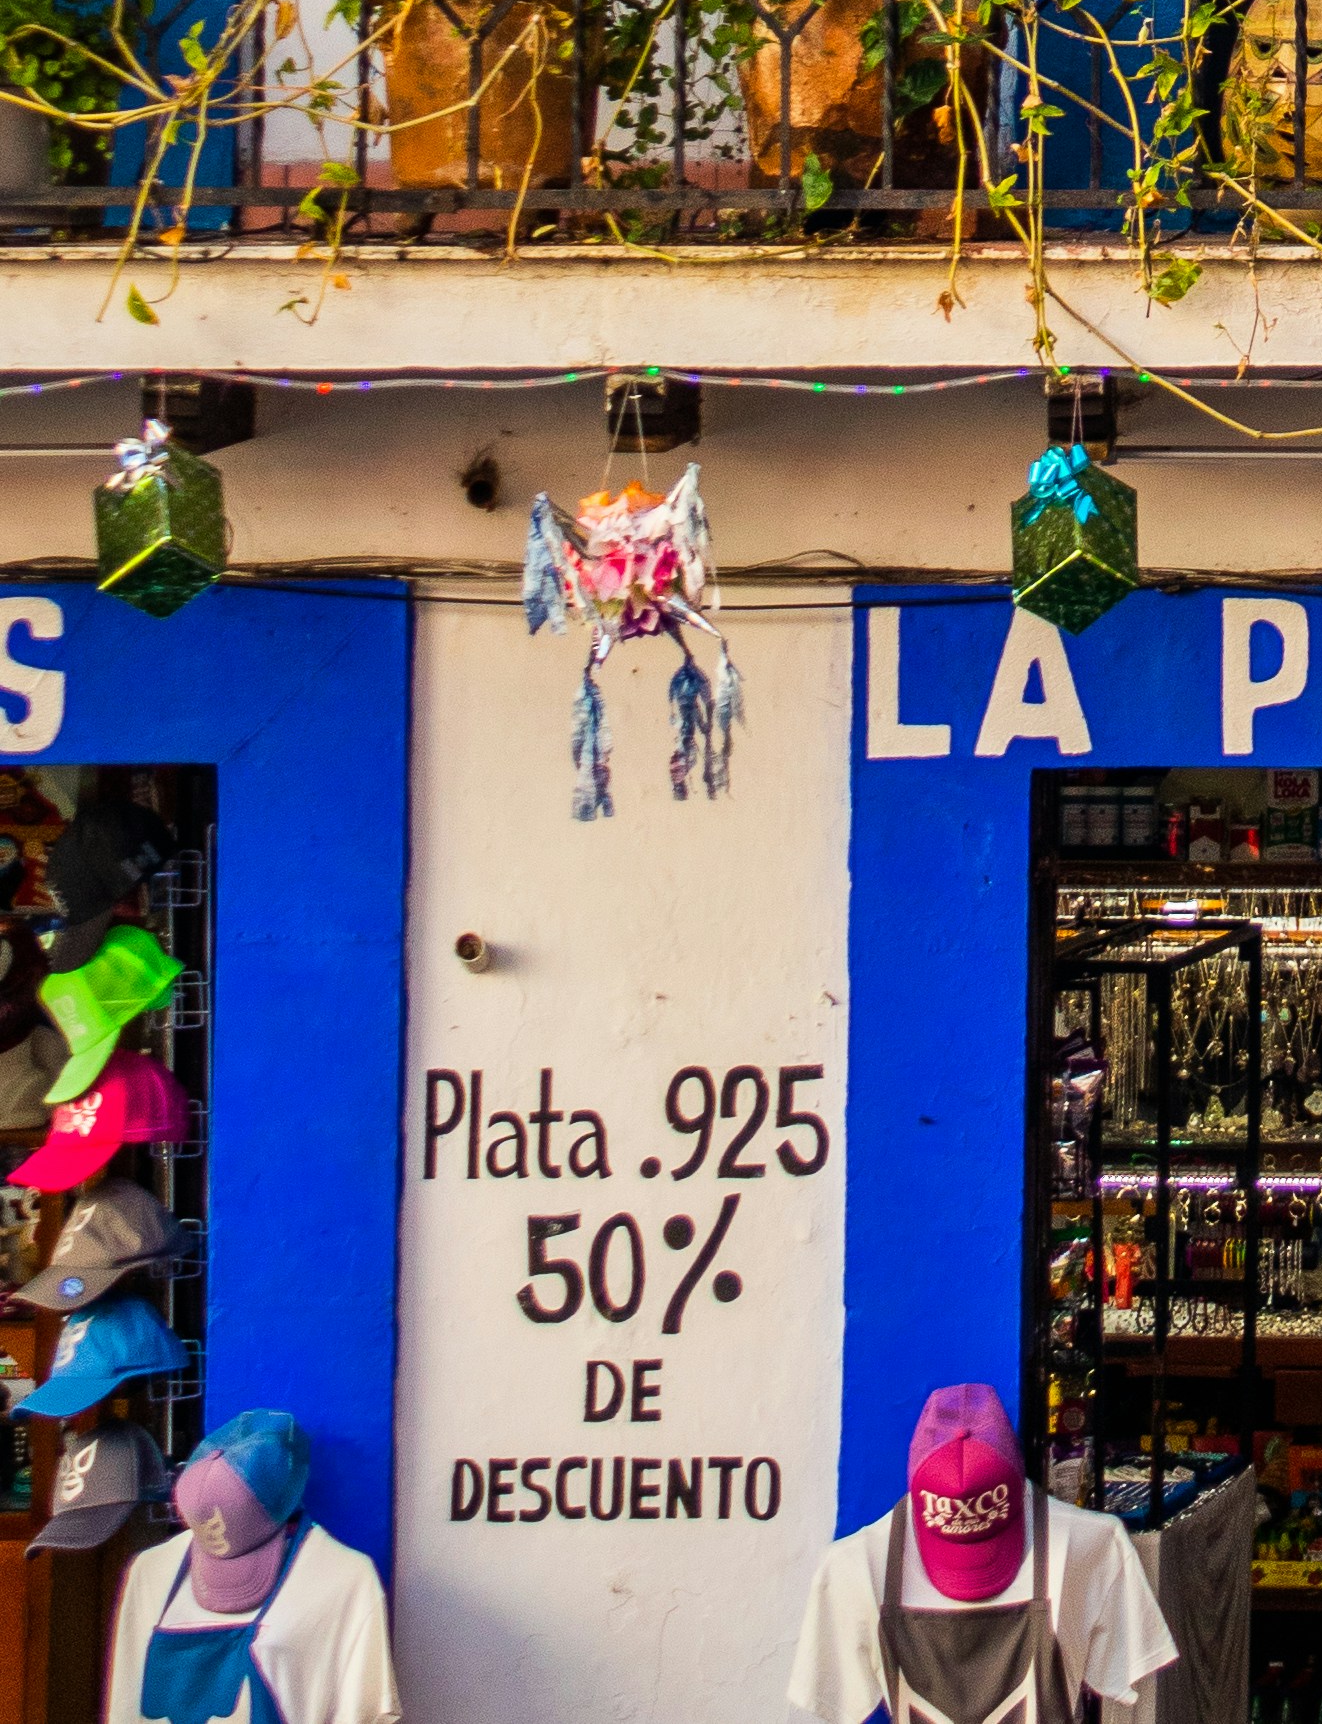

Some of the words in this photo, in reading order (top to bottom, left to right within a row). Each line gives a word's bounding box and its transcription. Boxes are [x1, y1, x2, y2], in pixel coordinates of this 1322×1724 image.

[867, 606, 1093, 758] LA
[423, 1067, 612, 1179] Plata
[640, 1064, 829, 1181] .925
[517, 1193, 743, 1335] 50%
[583, 1359, 663, 1422] DE
[450, 1456, 781, 1522] DESCUENTO
